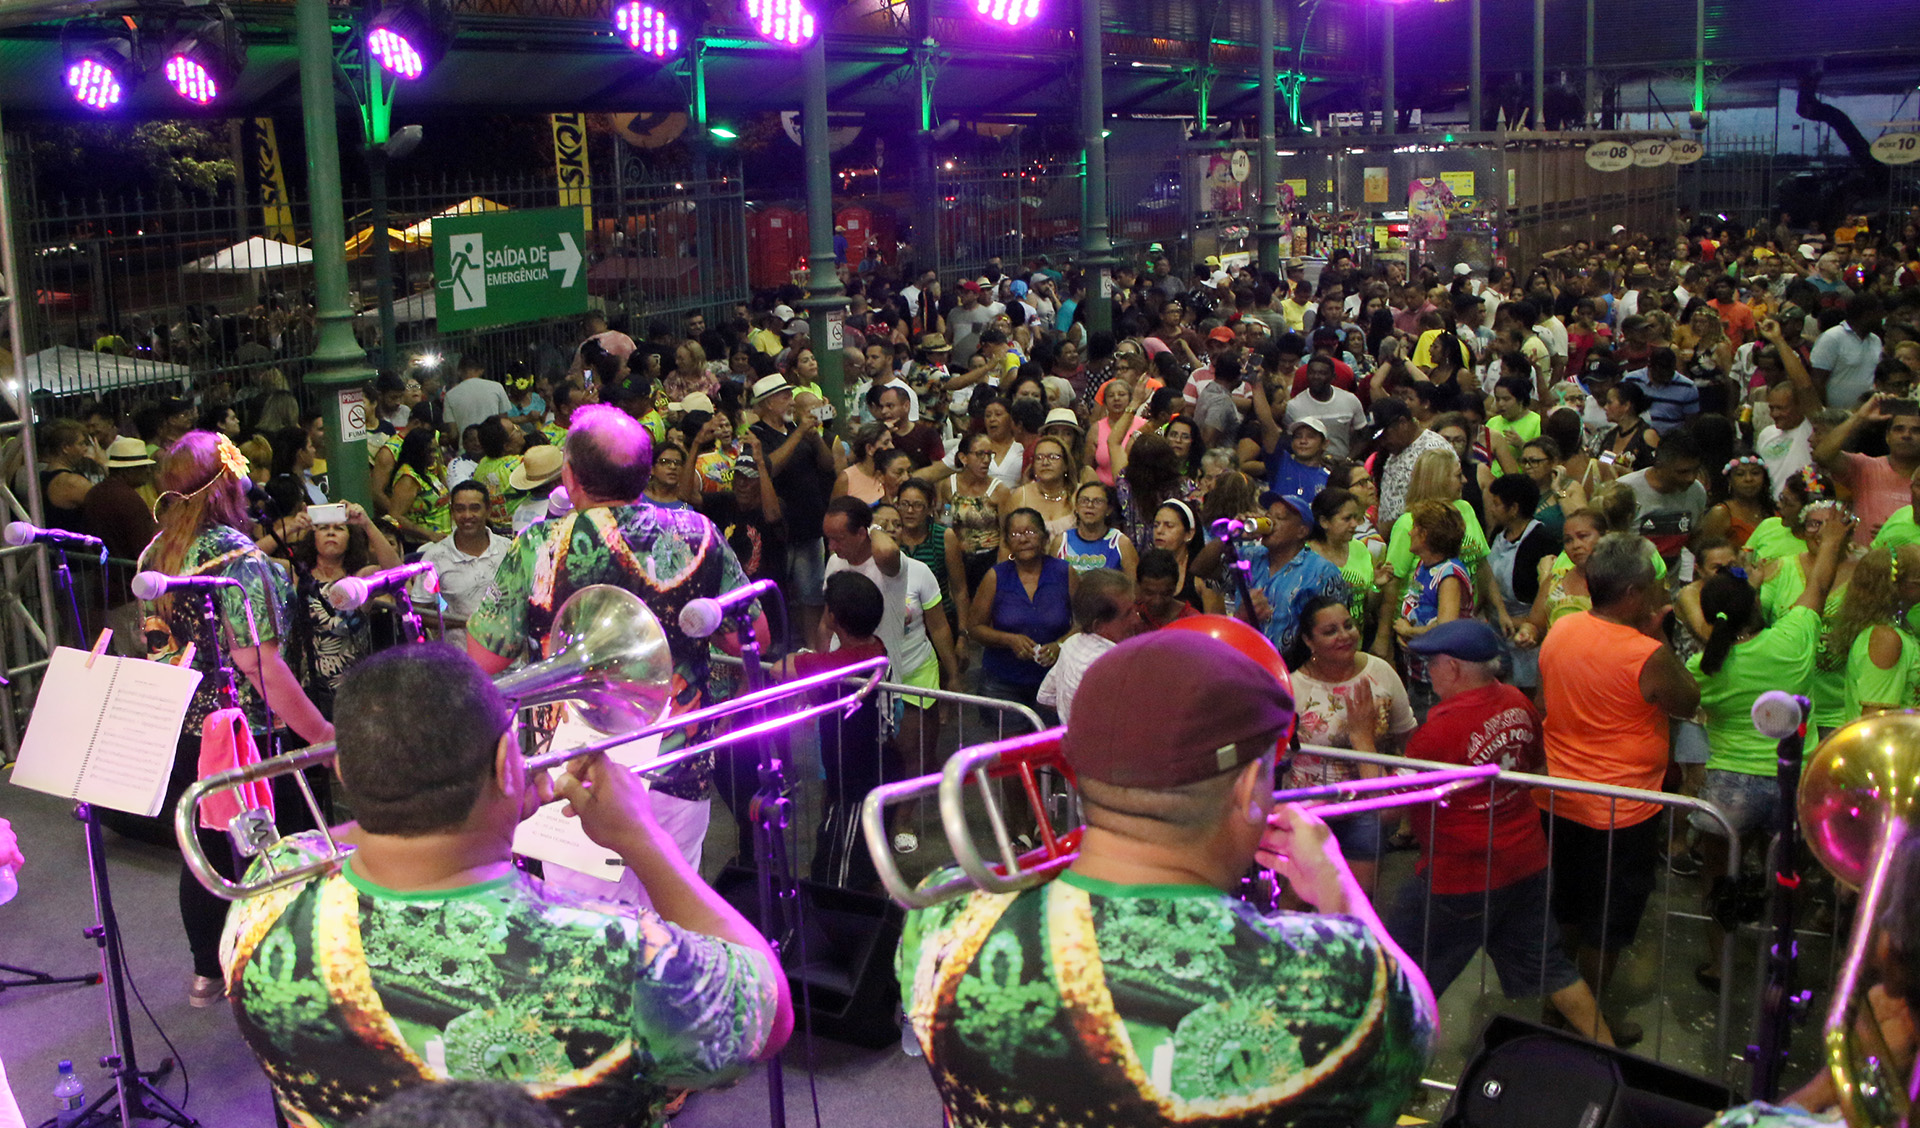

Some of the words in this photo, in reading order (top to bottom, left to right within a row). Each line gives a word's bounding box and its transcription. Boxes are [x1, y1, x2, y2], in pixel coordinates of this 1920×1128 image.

[555, 113, 584, 186] SKOL
[1649, 144, 1666, 155] 07
[1682, 143, 1698, 153] 06
[1898, 137, 1916, 150] 10
[1609, 146, 1628, 158] 08
[485, 245, 528, 268] SAÍDA
[530, 246, 548, 264] DE
[487, 266, 549, 286] EMERGÊNCIA
